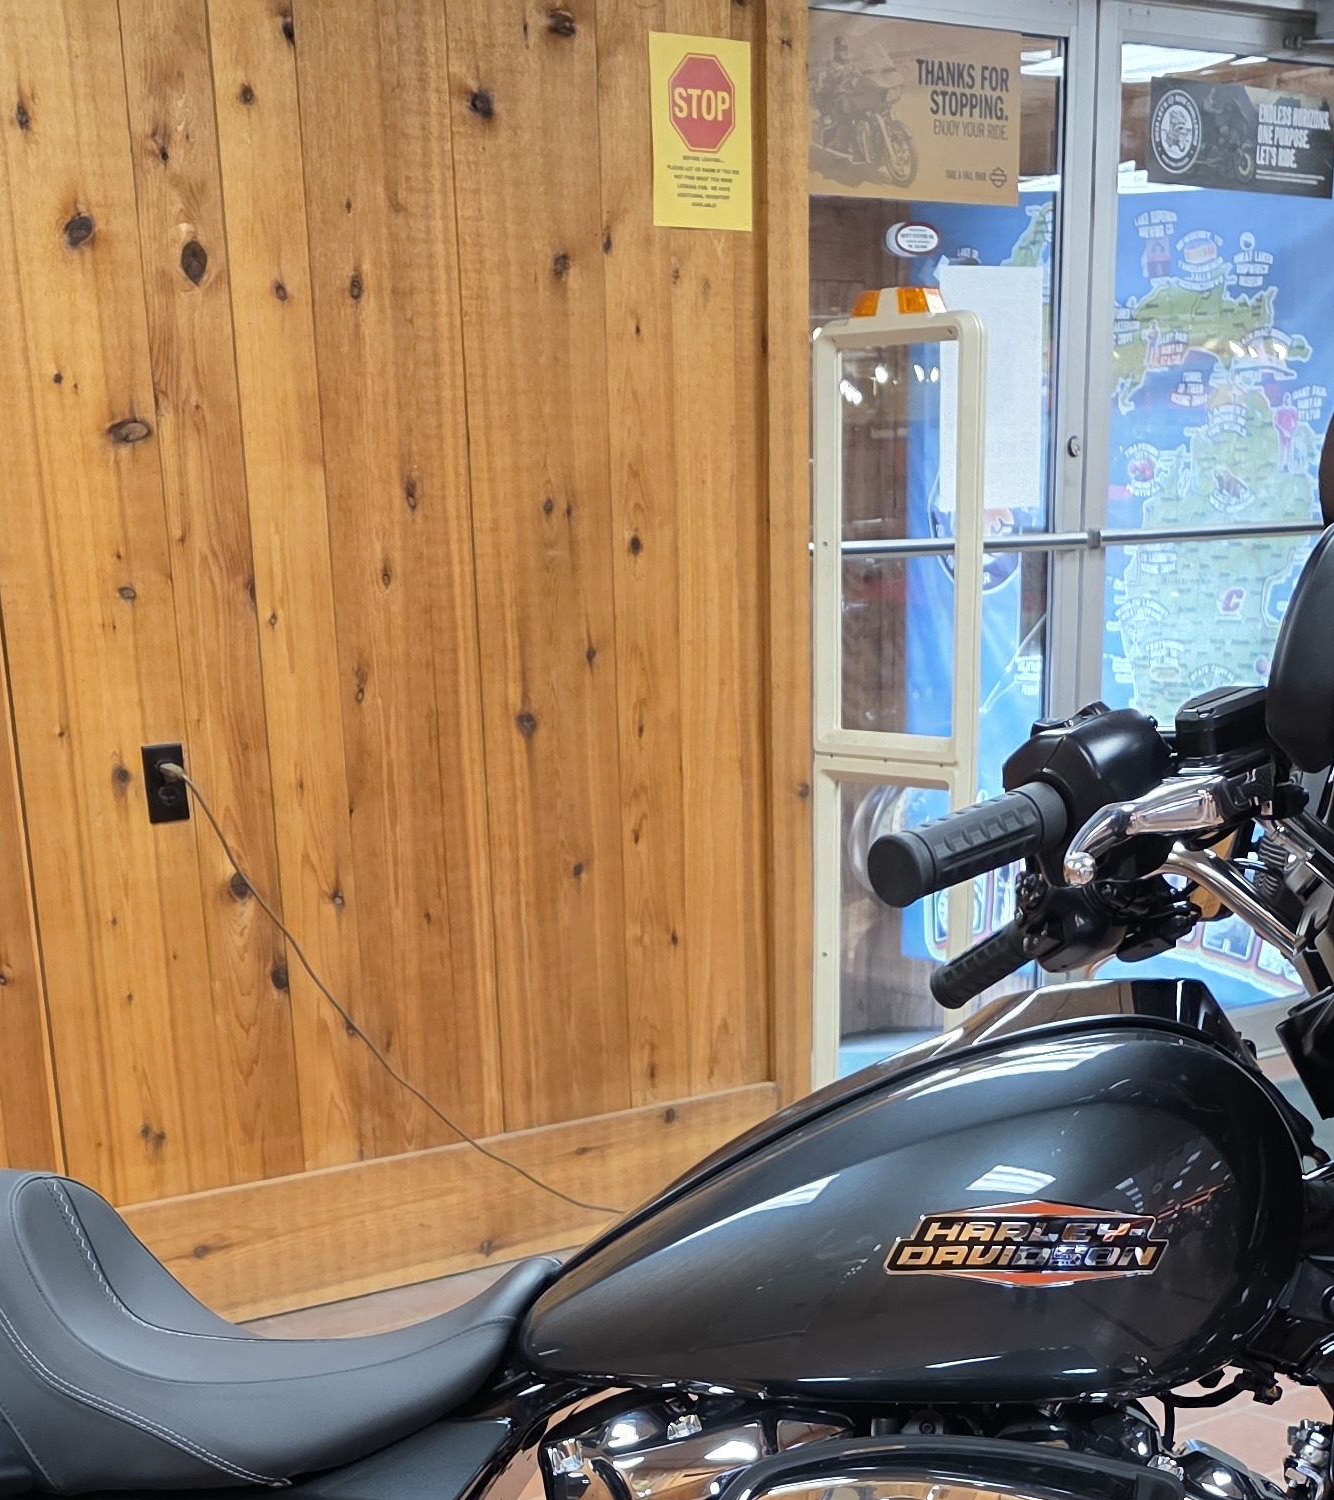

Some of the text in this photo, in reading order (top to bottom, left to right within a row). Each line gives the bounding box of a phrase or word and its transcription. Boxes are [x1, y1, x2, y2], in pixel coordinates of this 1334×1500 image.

[916, 59, 1009, 92] THANKS FOR
[674, 87, 730, 121] STOP
[930, 90, 1008, 122] STOPPING.
[1258, 104, 1292, 126] ENDLESS
[933, 119, 960, 137] ENJOY
[962, 121, 985, 139] YOUR
[1258, 125, 1310, 148] ONE PURPOSE.
[1256, 145, 1277, 166] LET'S
[1221, 589, 1244, 612] C
[923, 1221, 1145, 1243] HARLEY-
[896, 1245, 1158, 1267] DAVIDSON
